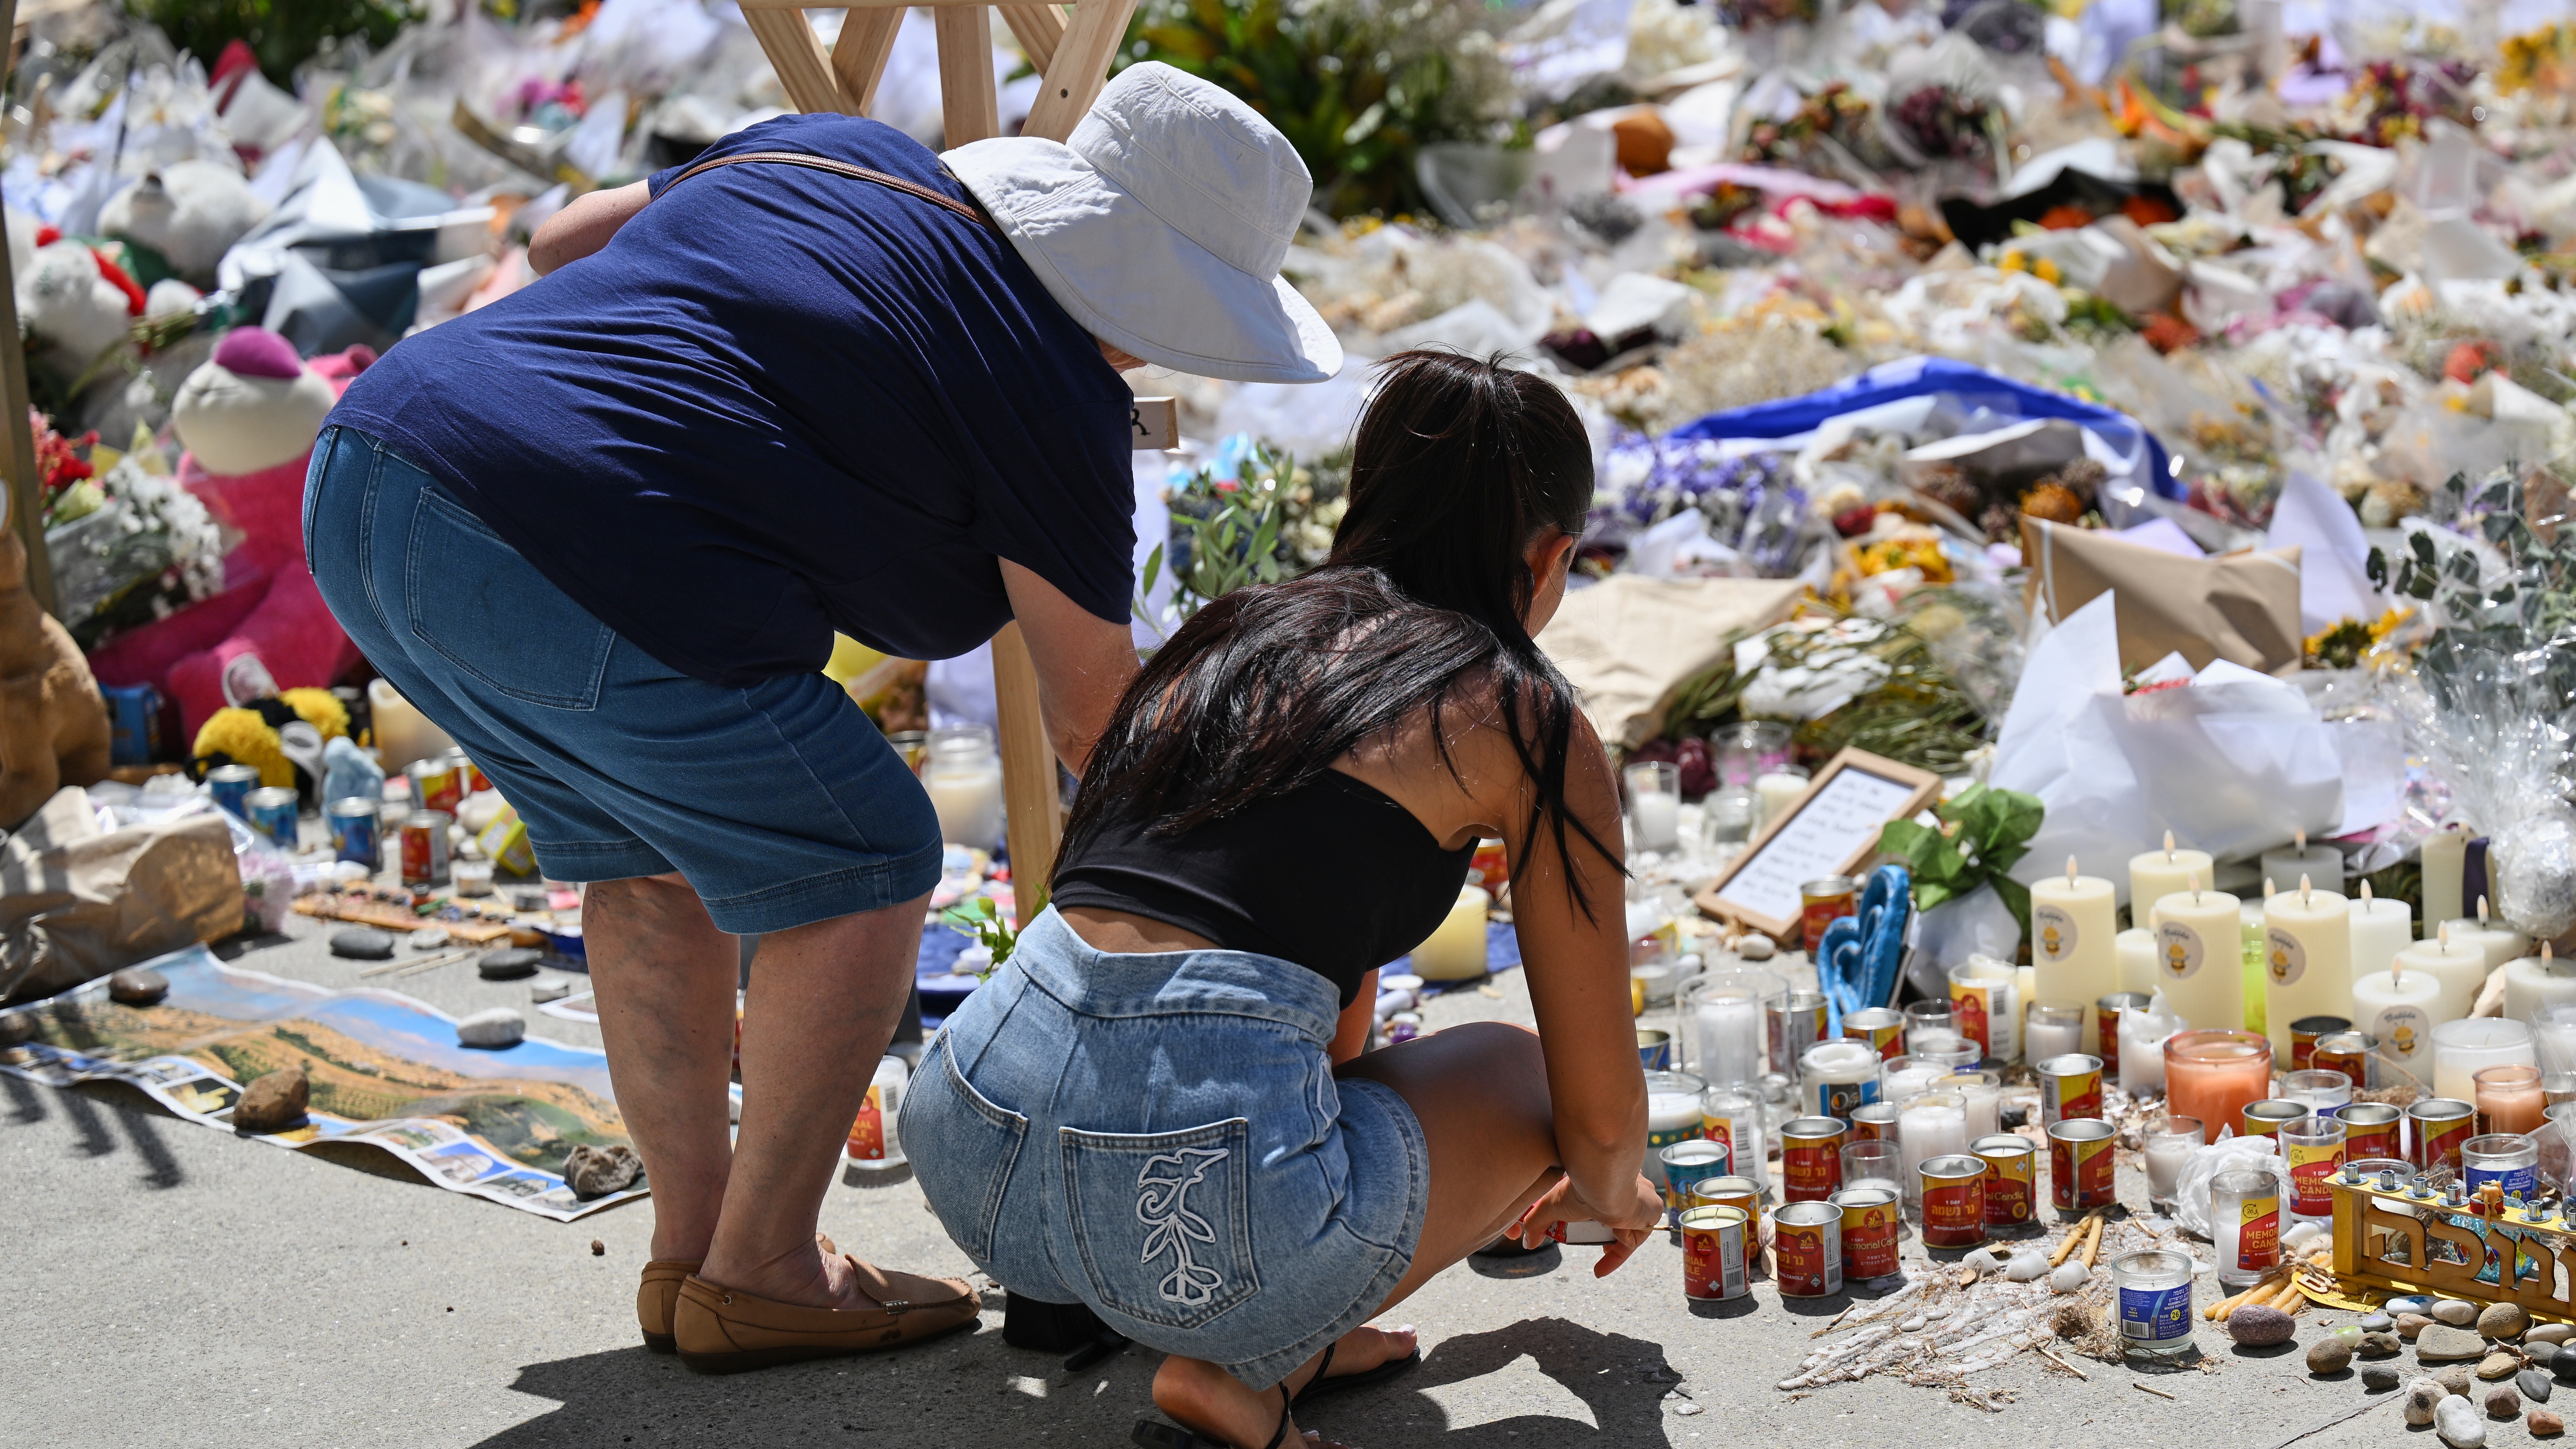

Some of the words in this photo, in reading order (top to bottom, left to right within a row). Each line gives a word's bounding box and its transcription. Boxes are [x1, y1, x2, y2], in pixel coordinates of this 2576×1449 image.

[1815, 1166, 1827, 1177] נר
[1995, 1191, 2025, 1201] Candle
[1932, 1205, 1962, 1216] נשמה
[1965, 1204, 1975, 1215] נר
[1793, 1255, 1804, 1266] נר
